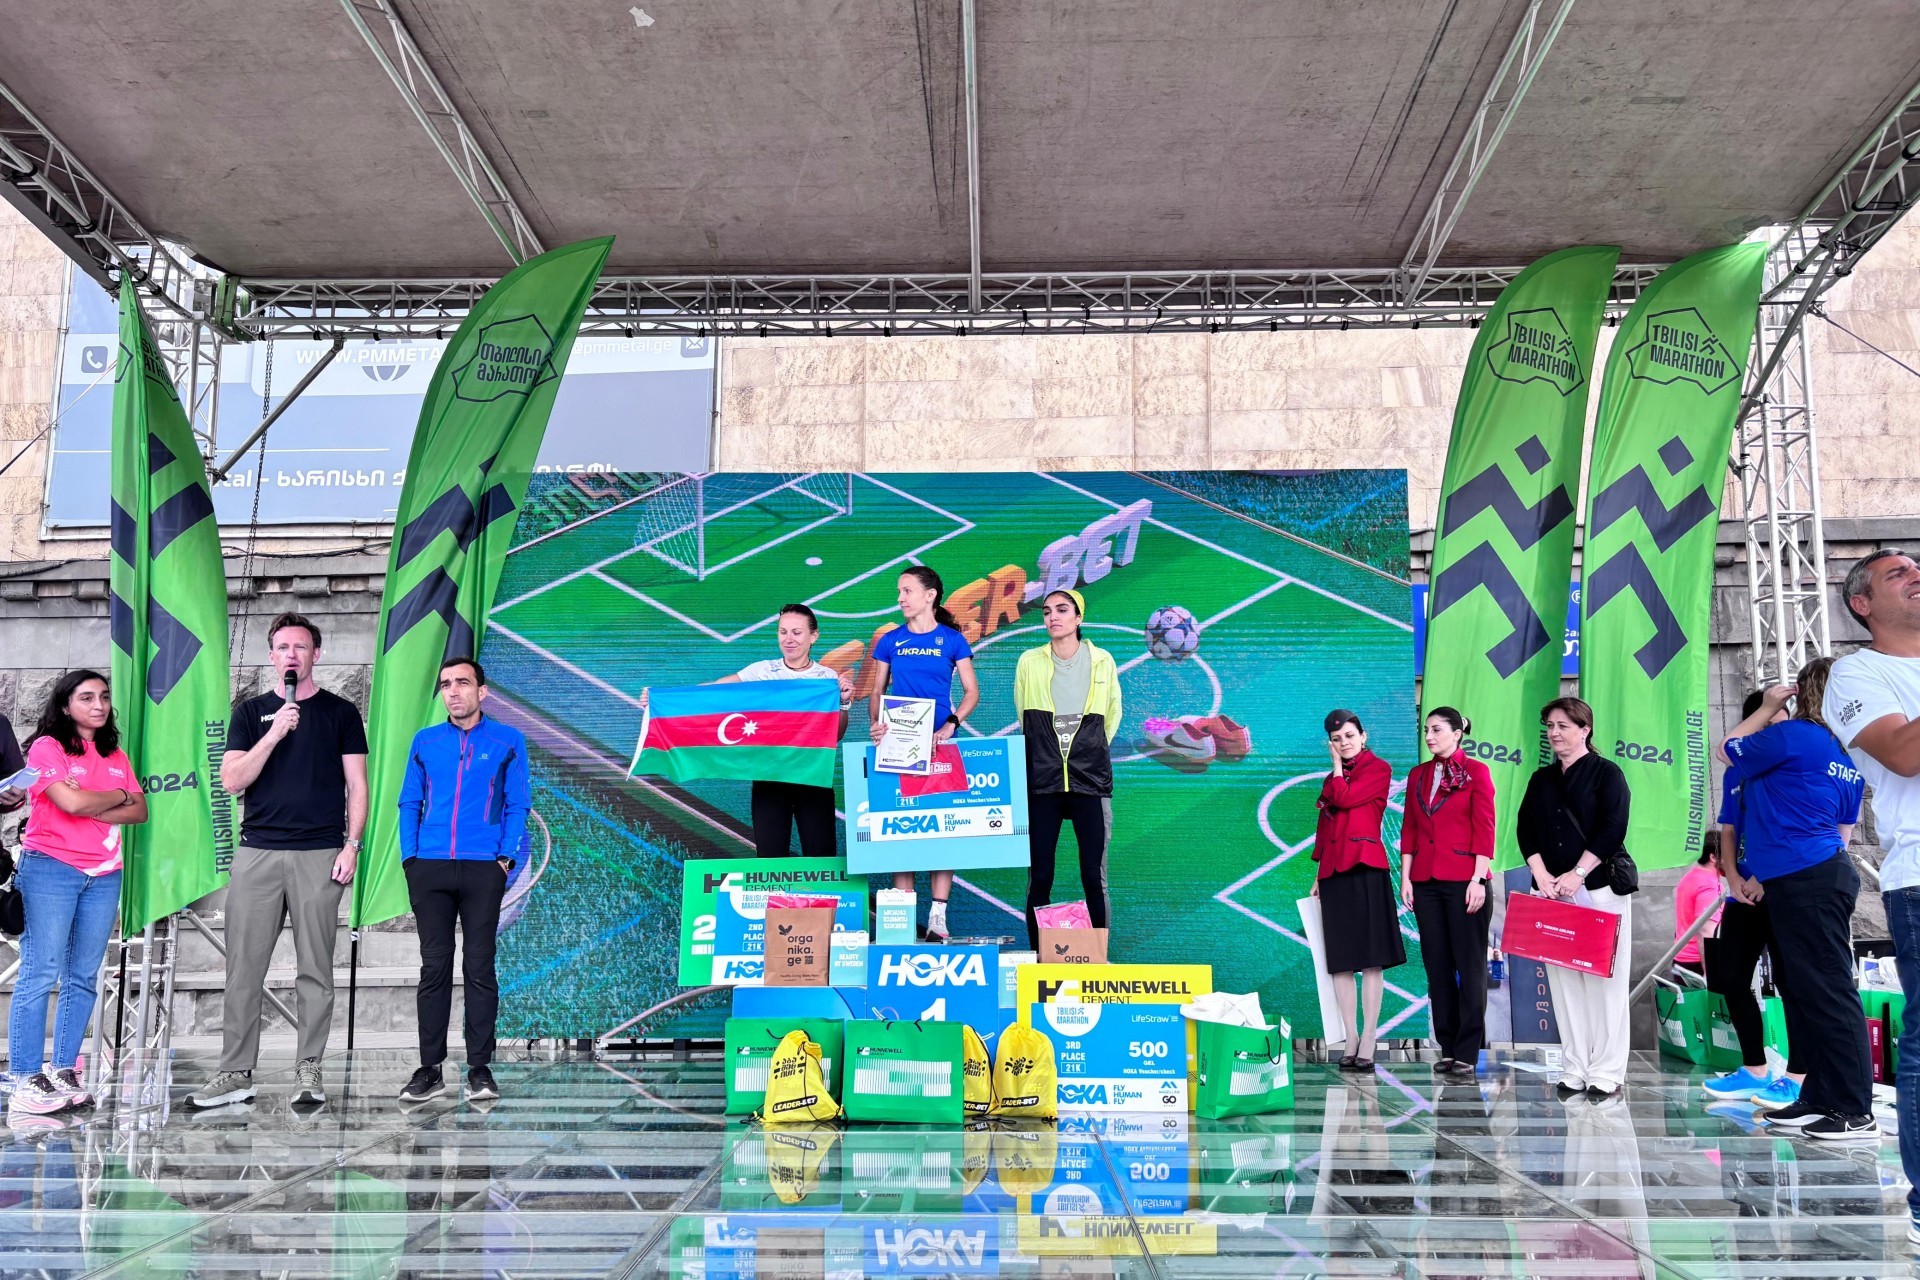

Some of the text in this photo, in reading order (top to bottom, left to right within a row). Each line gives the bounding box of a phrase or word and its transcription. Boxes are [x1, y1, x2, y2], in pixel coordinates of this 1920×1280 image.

[1513, 322, 1556, 351] TBILISI
[1652, 324, 1699, 352] TBILISI
[573, 338, 672, 356] @pmmetal.ge
[1508, 344, 1576, 382] MARATHON
[1650, 344, 1725, 379] MARATHON
[476, 362, 539, 388] მარათო
[215, 470, 253, 487] tal
[897, 648, 942, 657] UKRAINE
[961, 748, 994, 758] ifeStraw
[1463, 739, 1523, 766] 2024
[1615, 739, 1674, 767] 2024
[1827, 761, 1861, 785] STAFF
[141, 772, 199, 794] 2024
[967, 772, 1000, 789] 000
[1684, 709, 1704, 853] TBILISIMARATHON.GE
[900, 797, 915, 806] 21K
[881, 814, 940, 836] HOKA
[989, 820, 1003, 828] GO
[745, 870, 849, 884] HUNNEWELL
[745, 884, 794, 892] CEMENT
[742, 894, 763, 902] TBILISI
[741, 902, 768, 910] MARATH
[748, 923, 763, 931] 2ND
[743, 933, 765, 941] PLAC
[787, 935, 813, 945] orga
[747, 942, 762, 951] 21K
[787, 945, 814, 955] nika.
[787, 957, 802, 967] ge
[724, 960, 765, 979] HO
[877, 953, 989, 987] HOKA
[1081, 980, 1191, 995] HUNNEWELL
[1081, 995, 1132, 1004] CEMENT
[1057, 1007, 1078, 1016] TBILISI
[1056, 1015, 1089, 1025] MARATHON
[1131, 1014, 1169, 1023] LifeStraw
[1065, 1041, 1081, 1050] 3RD
[1128, 1041, 1168, 1058] 500
[1061, 1052, 1086, 1061] PLACE
[1065, 1064, 1081, 1072] 21K
[1138, 1067, 1176, 1075] Voucher/check
[1113, 1084, 1125, 1092] FLY
[1113, 1091, 1142, 1099] HUMAN
[1162, 1095, 1177, 1104] GO
[773, 1096, 817, 1112] LEADER-BET
